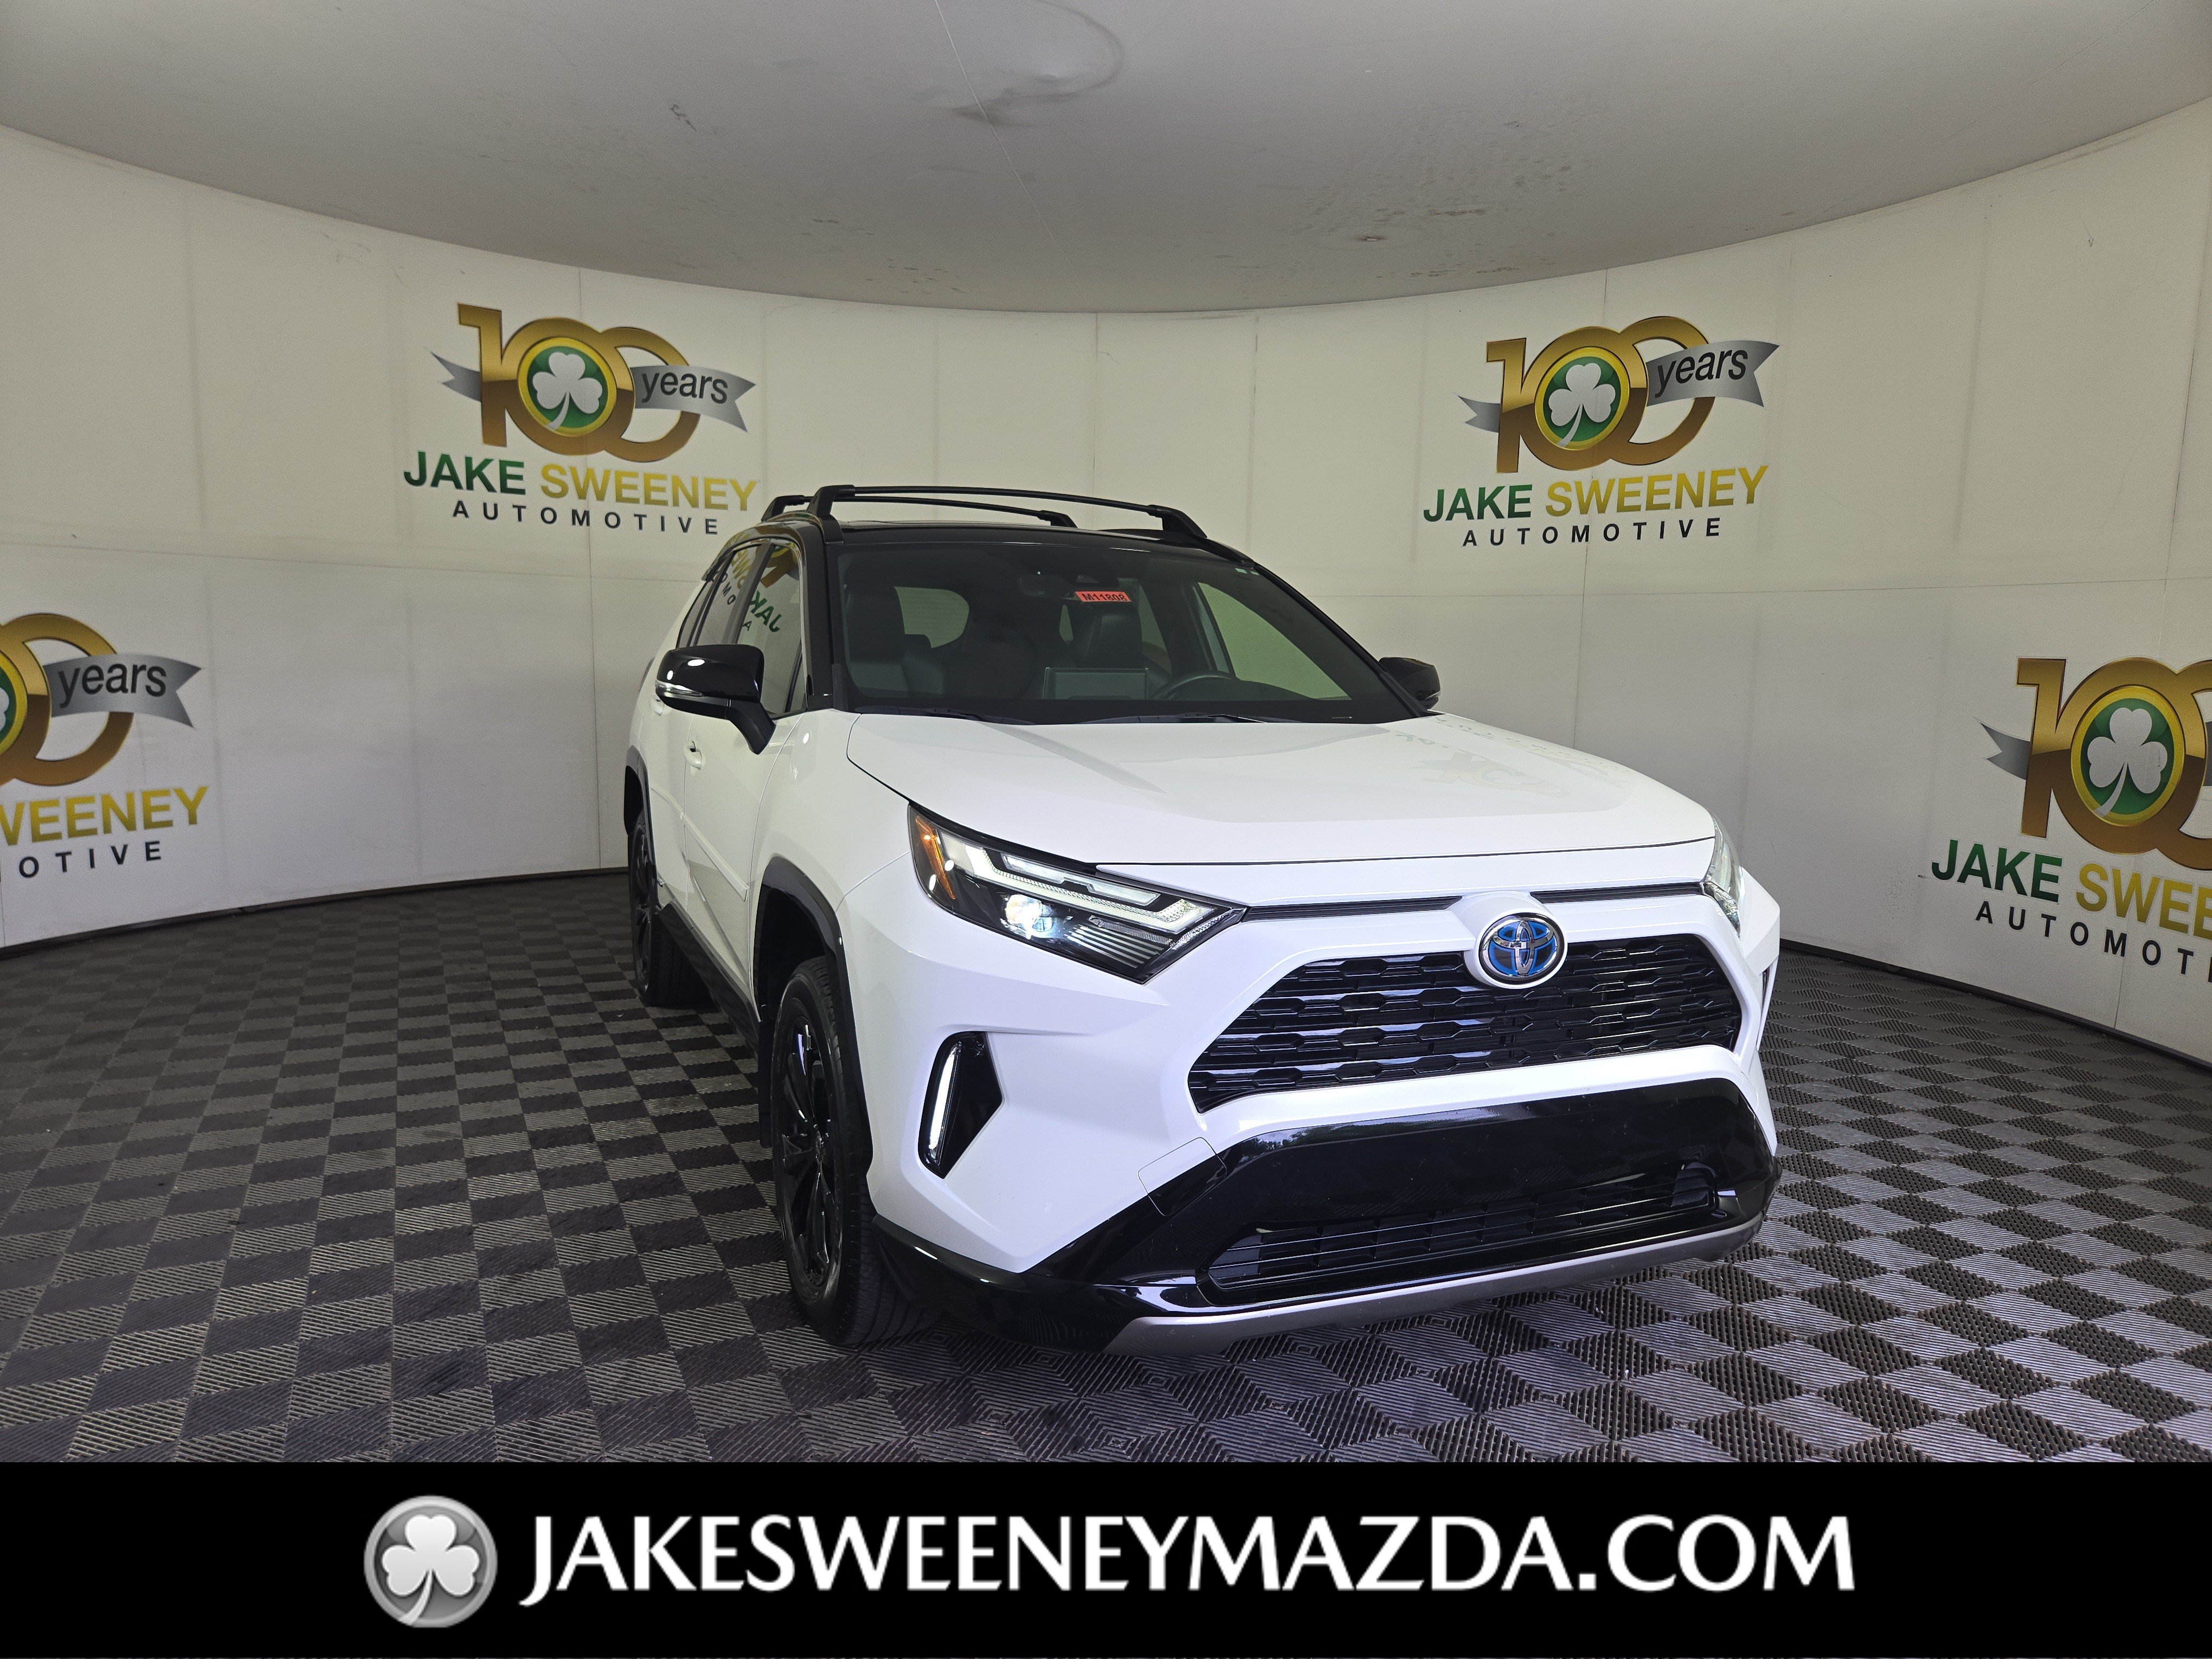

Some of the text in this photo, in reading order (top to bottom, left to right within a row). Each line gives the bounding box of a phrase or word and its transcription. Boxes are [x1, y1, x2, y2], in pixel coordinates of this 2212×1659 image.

[457, 302, 728, 463] 100 years
[1486, 316, 1749, 473] 100 years
[403, 451, 758, 512] JAKE SWEENEY
[1423, 465, 1769, 522] JAKE SWEENEY
[453, 500, 718, 535] AUTOMOTIVE
[1462, 518, 1720, 547] AUTOMOTIVE
[58, 663, 168, 708] years
[19, 841, 161, 878] OTIVE
[1931, 839, 2062, 902] JAKE
